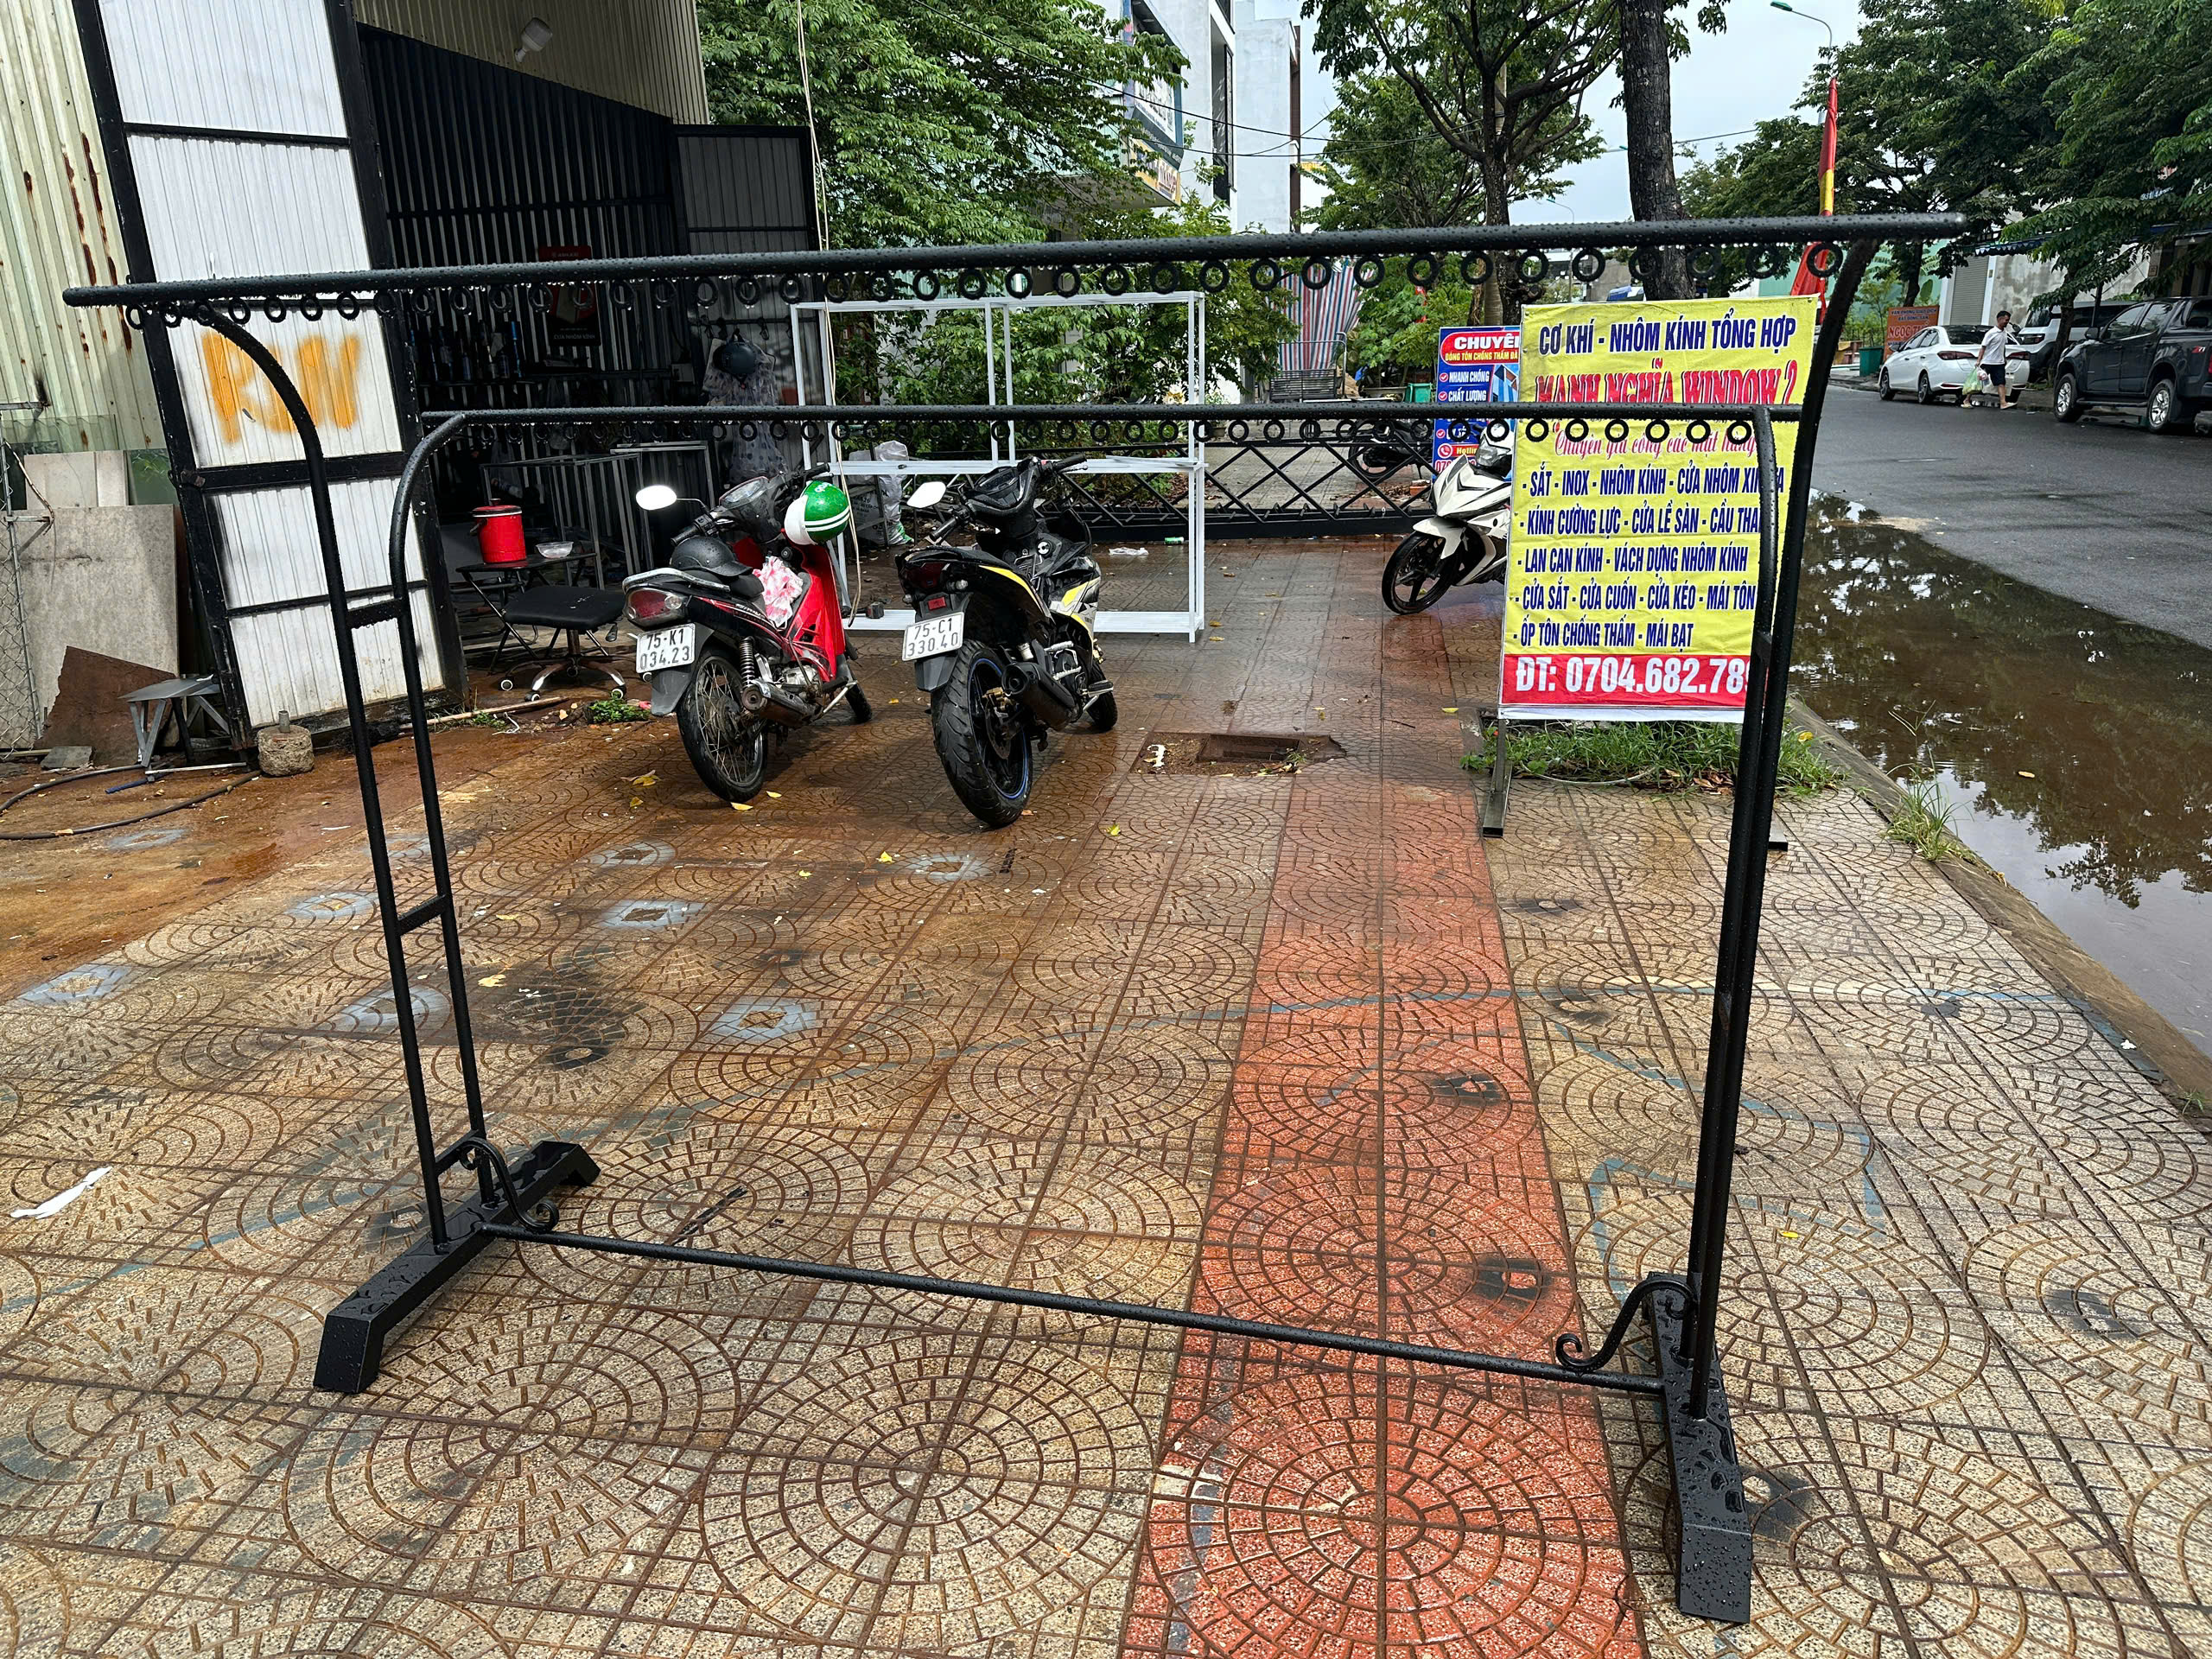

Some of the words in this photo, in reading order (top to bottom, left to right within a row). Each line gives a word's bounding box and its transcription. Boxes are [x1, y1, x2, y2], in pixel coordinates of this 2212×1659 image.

[1540, 323, 1562, 354] CƠ
[1566, 318, 1594, 353] KHÍ
[1610, 317, 1660, 352] NHÔM
[1665, 315, 1707, 350] KÍNH
[1712, 308, 1756, 348] TỔNG
[1760, 315, 1796, 353] HỢP
[1461, 351, 1472, 360] TÔN
[1473, 350, 1492, 360] CHỐNG
[1494, 349, 1509, 359] THẤM
[1449, 372, 1469, 383] NHANH
[1469, 369, 1490, 382] CHÓNG
[1681, 369, 1782, 404] WINDOW
[1448, 387, 1465, 402] CHẤT
[1465, 390, 1486, 403] LƯỢNG
[1530, 461, 1552, 496] SẮT
[1562, 470, 1590, 495] INOX
[1599, 464, 1636, 495] NHÔM
[1637, 463, 1666, 494] KÍNH
[1677, 460, 1700, 494] CỬA
[1704, 462, 1740, 493] NHÔM
[1528, 505, 1554, 535] KÍNH
[1558, 503, 1596, 534] CƯỜNG
[1599, 506, 1621, 539] LỰC
[1632, 499, 1654, 533] CỬA
[1675, 503, 1699, 533] SÀN
[1710, 499, 1734, 533] CẦU
[1737, 507, 1761, 532] THA
[1525, 549, 1547, 572] LAN
[1550, 548, 1573, 572] CAN
[1575, 543, 1604, 572] KÍNH
[1615, 542, 1644, 571] VÁCH
[1647, 544, 1678, 577] DỰNG
[1681, 542, 1717, 571] NHÔM
[1719, 541, 1748, 571] KÍNH
[1523, 578, 1544, 609] CỬA
[1548, 576, 1569, 609] SẮT
[1580, 577, 1601, 609] CỬA
[1605, 576, 1637, 609] CUỐN
[1648, 577, 1669, 609] CỬA
[1673, 580, 1696, 609] KÉO
[1707, 580, 1730, 609] MÁI
[1733, 580, 1756, 609] TÔN
[646, 628, 684, 650] 75-K1
[906, 632, 958, 657] 330.40
[914, 617, 952, 640] 75-C1
[1521, 614, 1535, 646] ỐP
[1539, 618, 1560, 646] TÔN
[1562, 614, 1600, 646] CHỐNG
[1605, 614, 1636, 646] THẤM
[1645, 618, 1669, 646] MÁI
[1671, 623, 1694, 652] BẠT
[640, 645, 690, 670] 034.23
[1516, 657, 1556, 691] ĐT:
[1566, 657, 1750, 694] 0704.682.78
